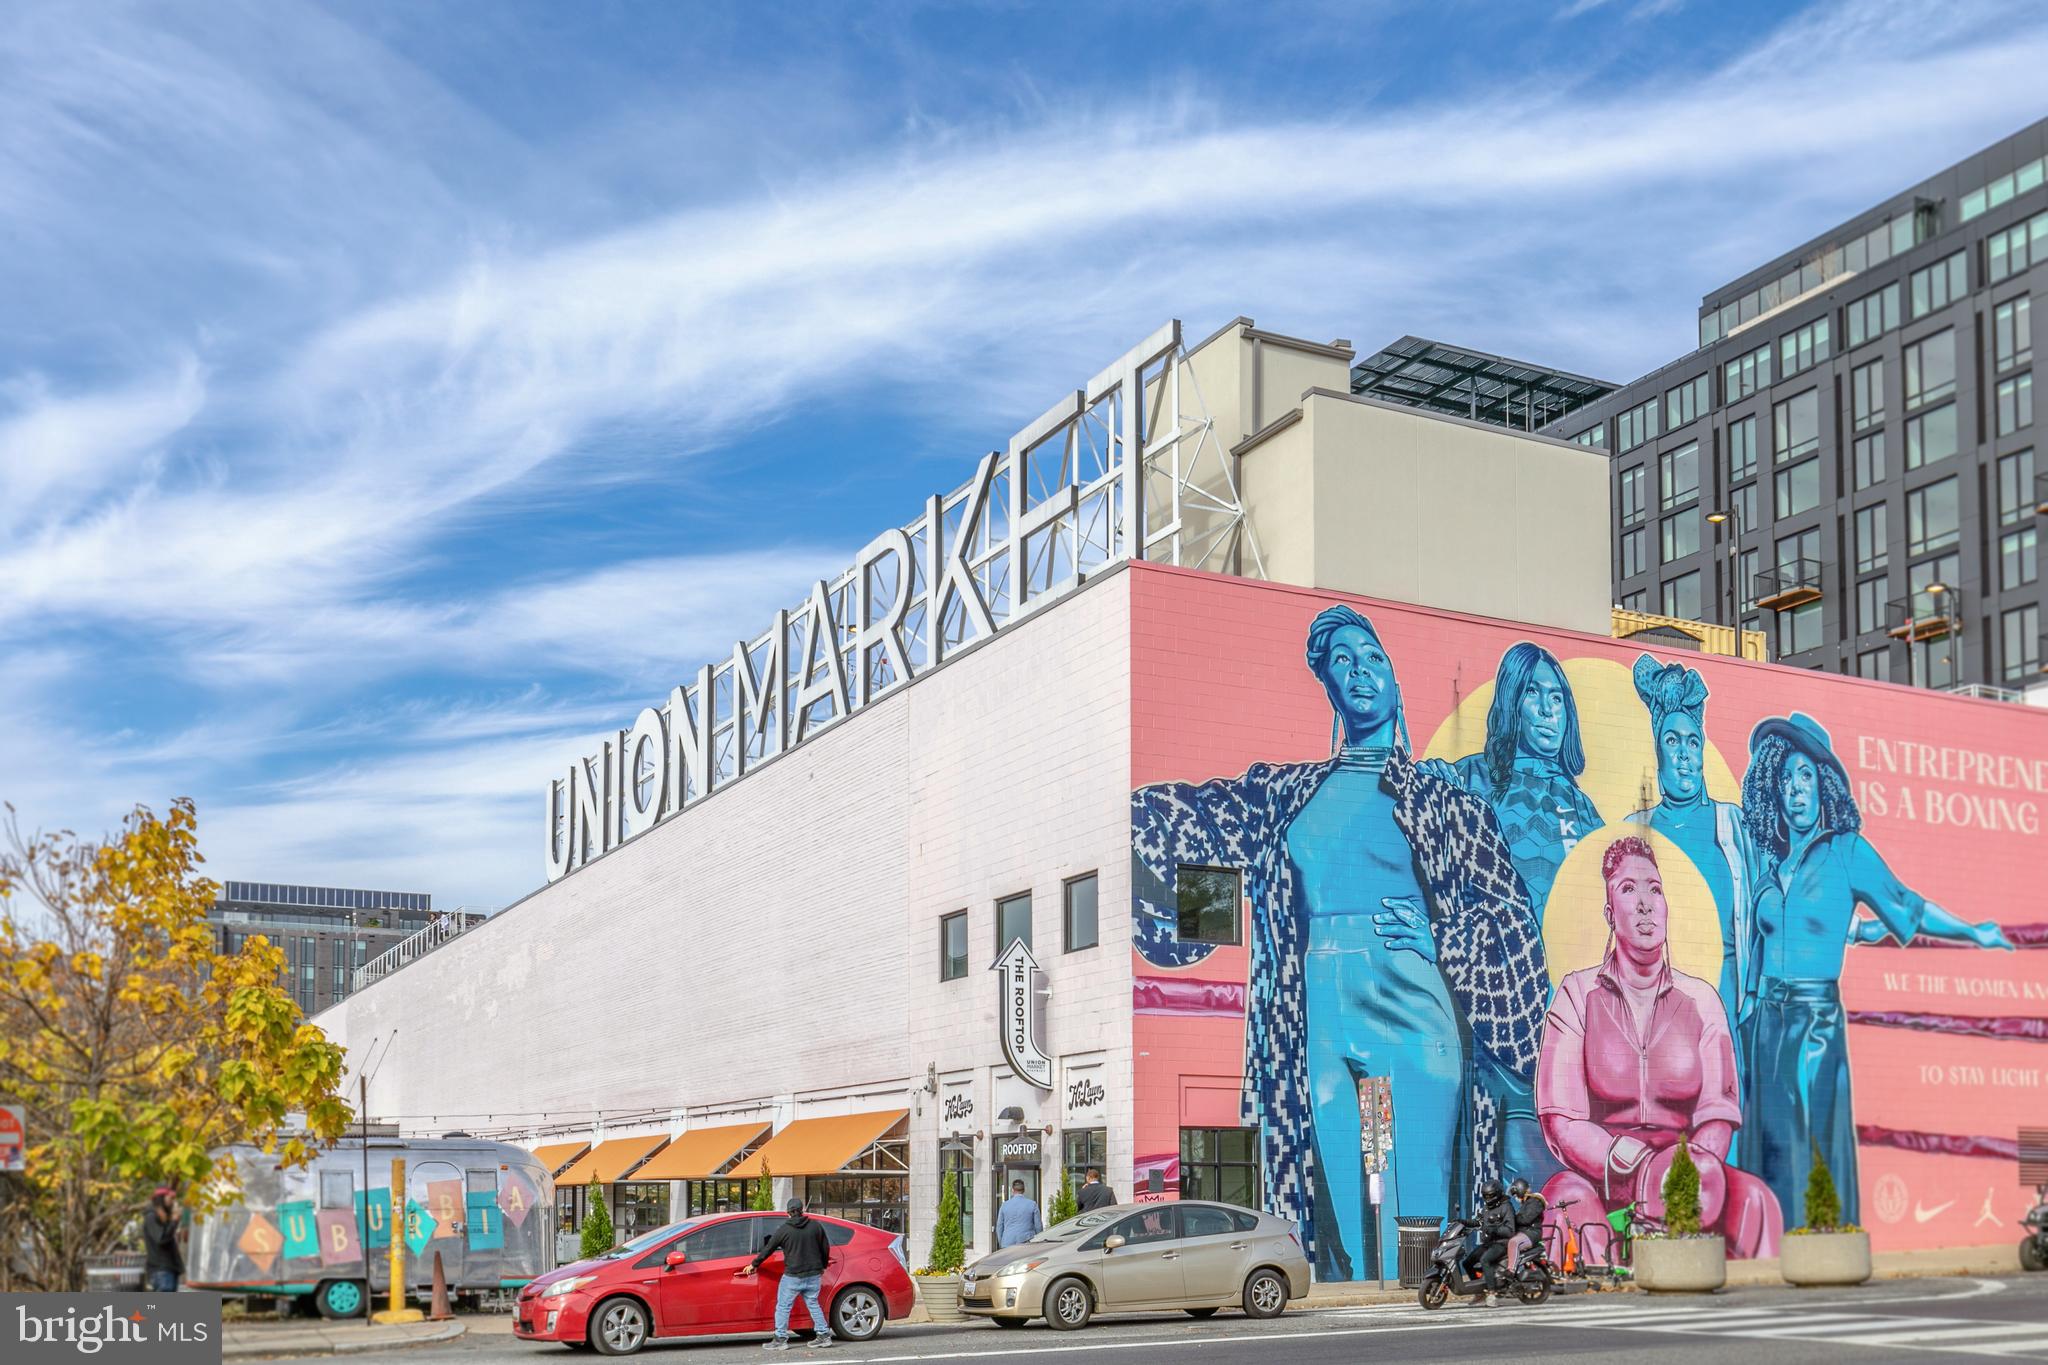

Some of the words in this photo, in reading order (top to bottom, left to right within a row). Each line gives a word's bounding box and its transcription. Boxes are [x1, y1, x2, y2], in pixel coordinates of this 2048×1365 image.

[546, 664, 713, 882] UNION
[733, 319, 1181, 777] MARKET
[1858, 780, 1889, 817] IS
[1896, 786, 1917, 820] A
[1925, 788, 2040, 835] BOXING
[1015, 956, 1024, 983] THE
[1884, 973, 1909, 992] WE
[1917, 974, 1949, 994] THE
[1954, 976, 2019, 999] WOMEN
[1015, 987, 1025, 1054] ROOFTOP
[1920, 1064, 1945, 1085] TO
[1949, 1066, 1985, 1086] STAY
[1991, 1067, 2040, 1088] LIGHT
[1068, 1078, 1105, 1111] Hi-Lawn
[1002, 1143, 1038, 1155] ROOFTOP
